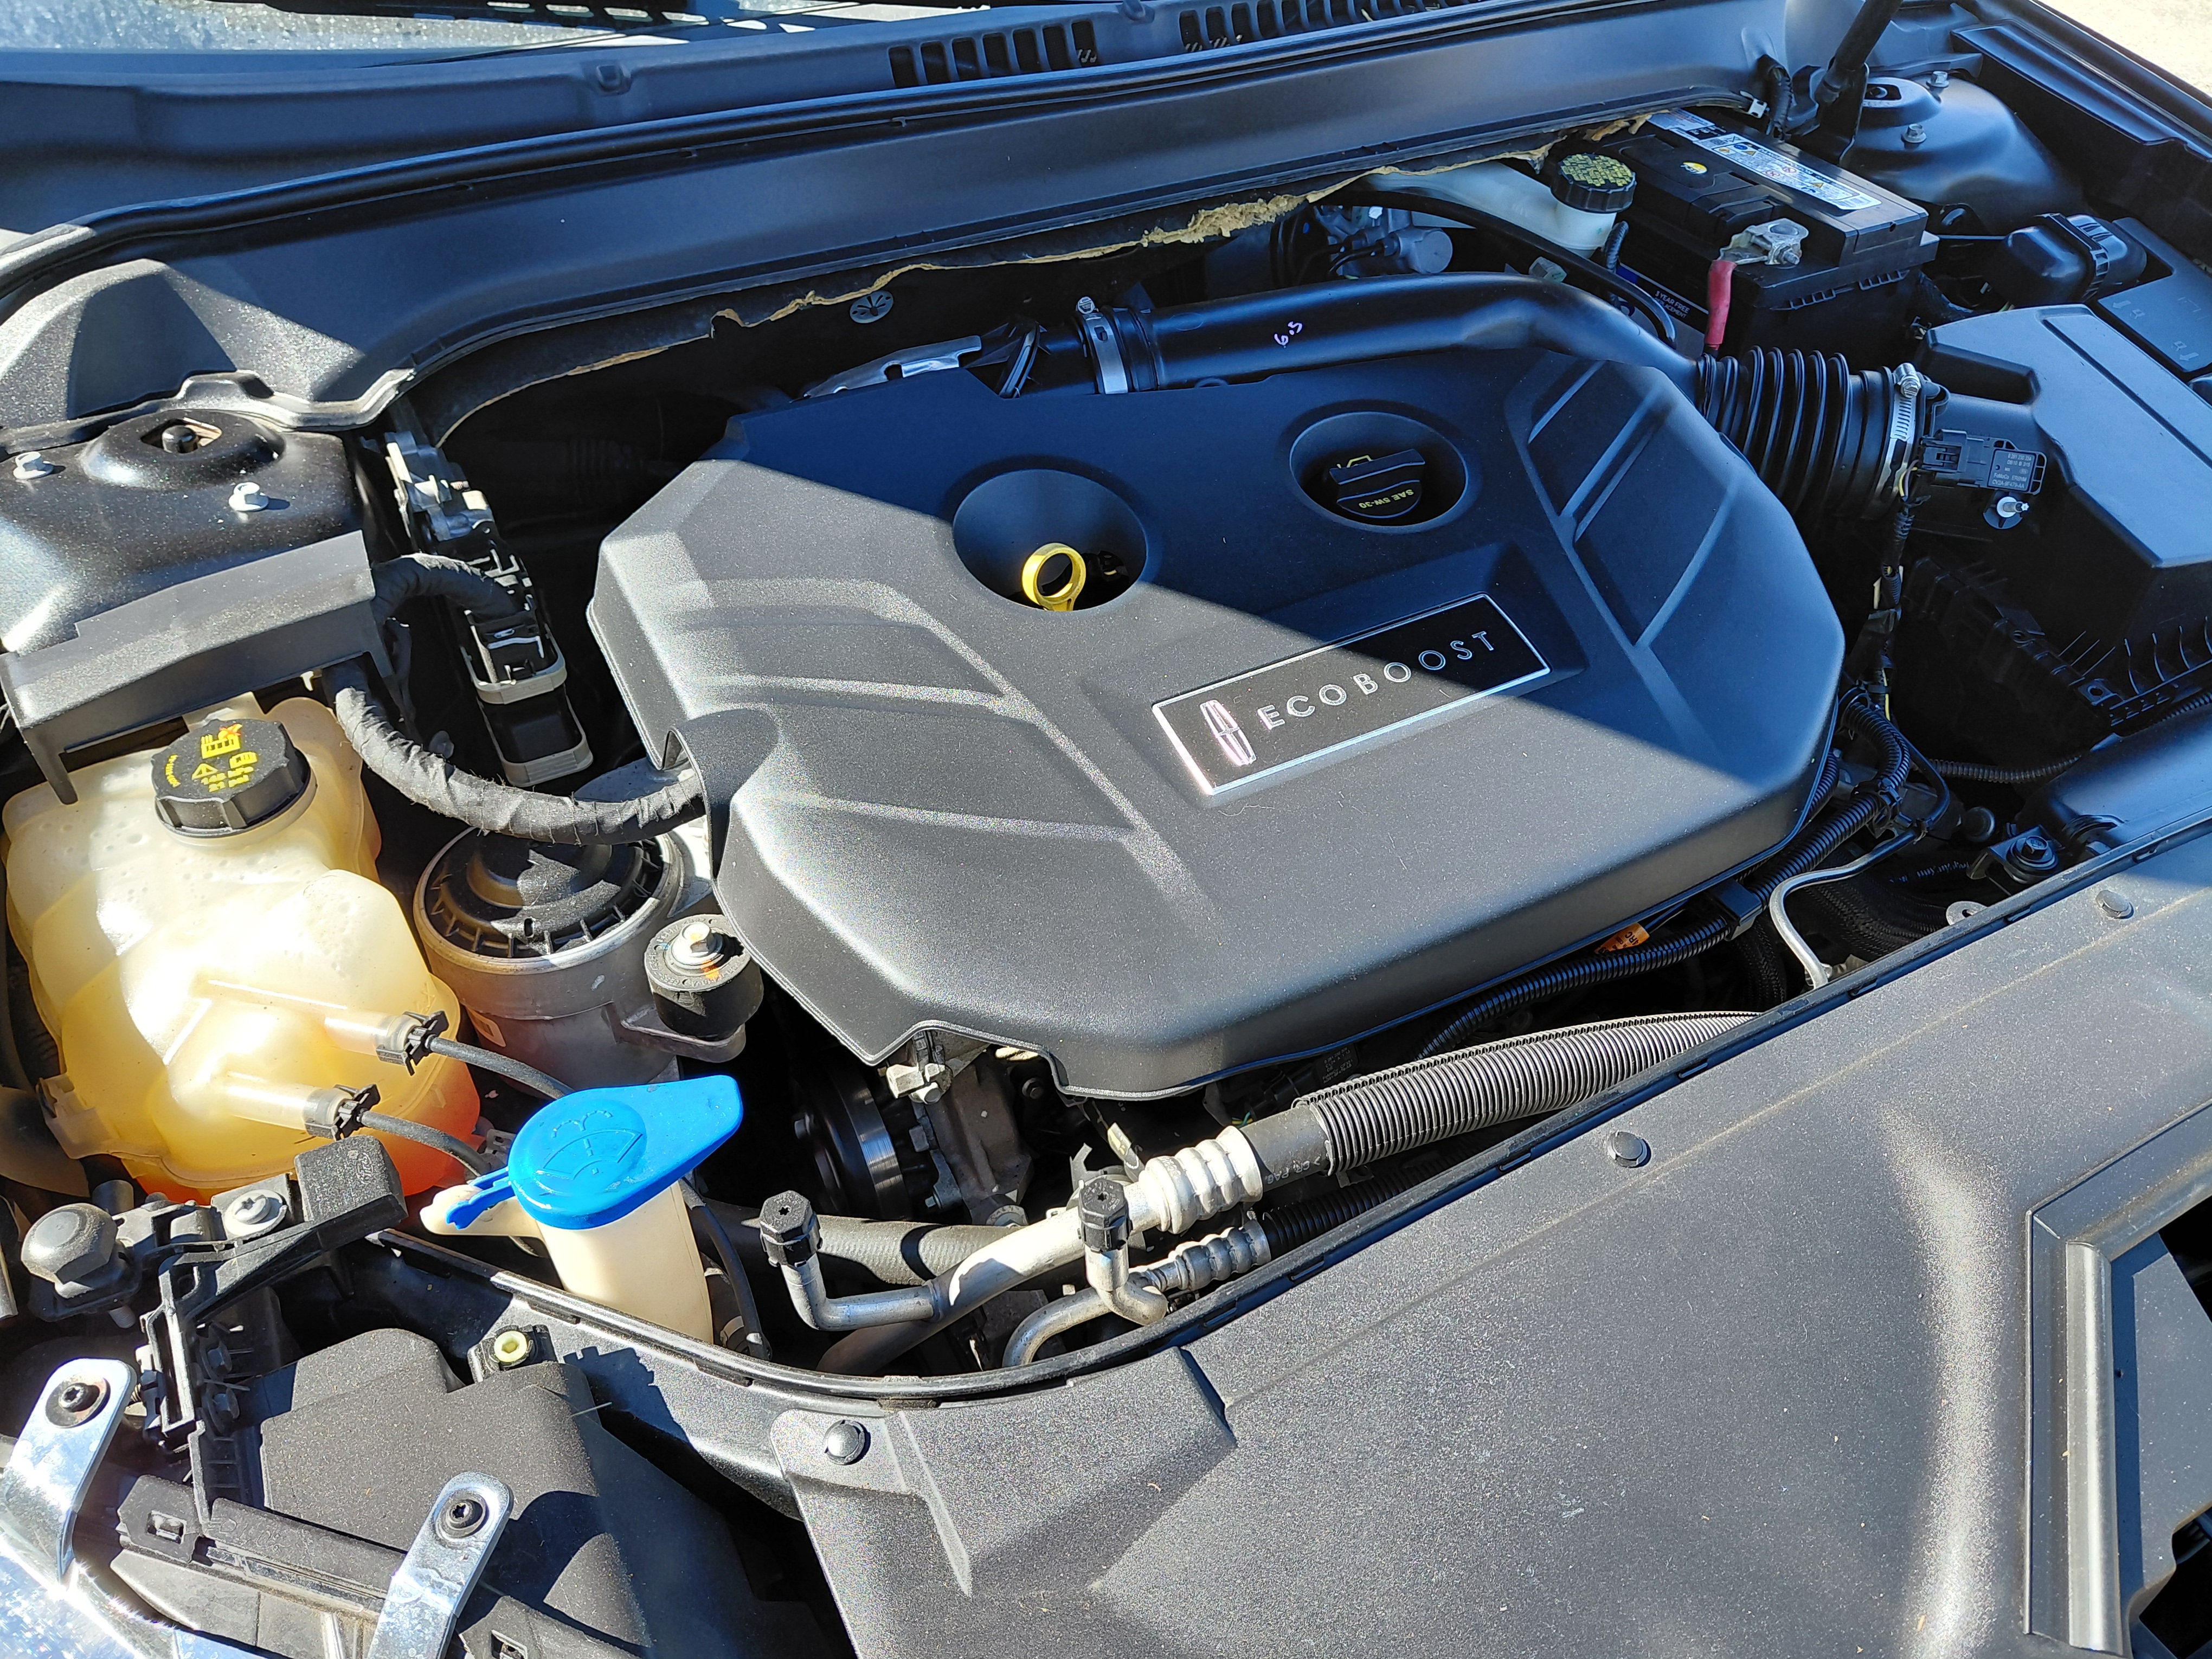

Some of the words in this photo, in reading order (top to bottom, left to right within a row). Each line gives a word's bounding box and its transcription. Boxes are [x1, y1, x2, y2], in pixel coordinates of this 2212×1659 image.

[1660, 292, 1675, 305] YEAR
[1674, 301, 1690, 313] FREE
[1359, 497, 1391, 509] 5W-30
[1391, 488, 1415, 501] SAE
[1257, 630, 1496, 731] ECOBOOST
